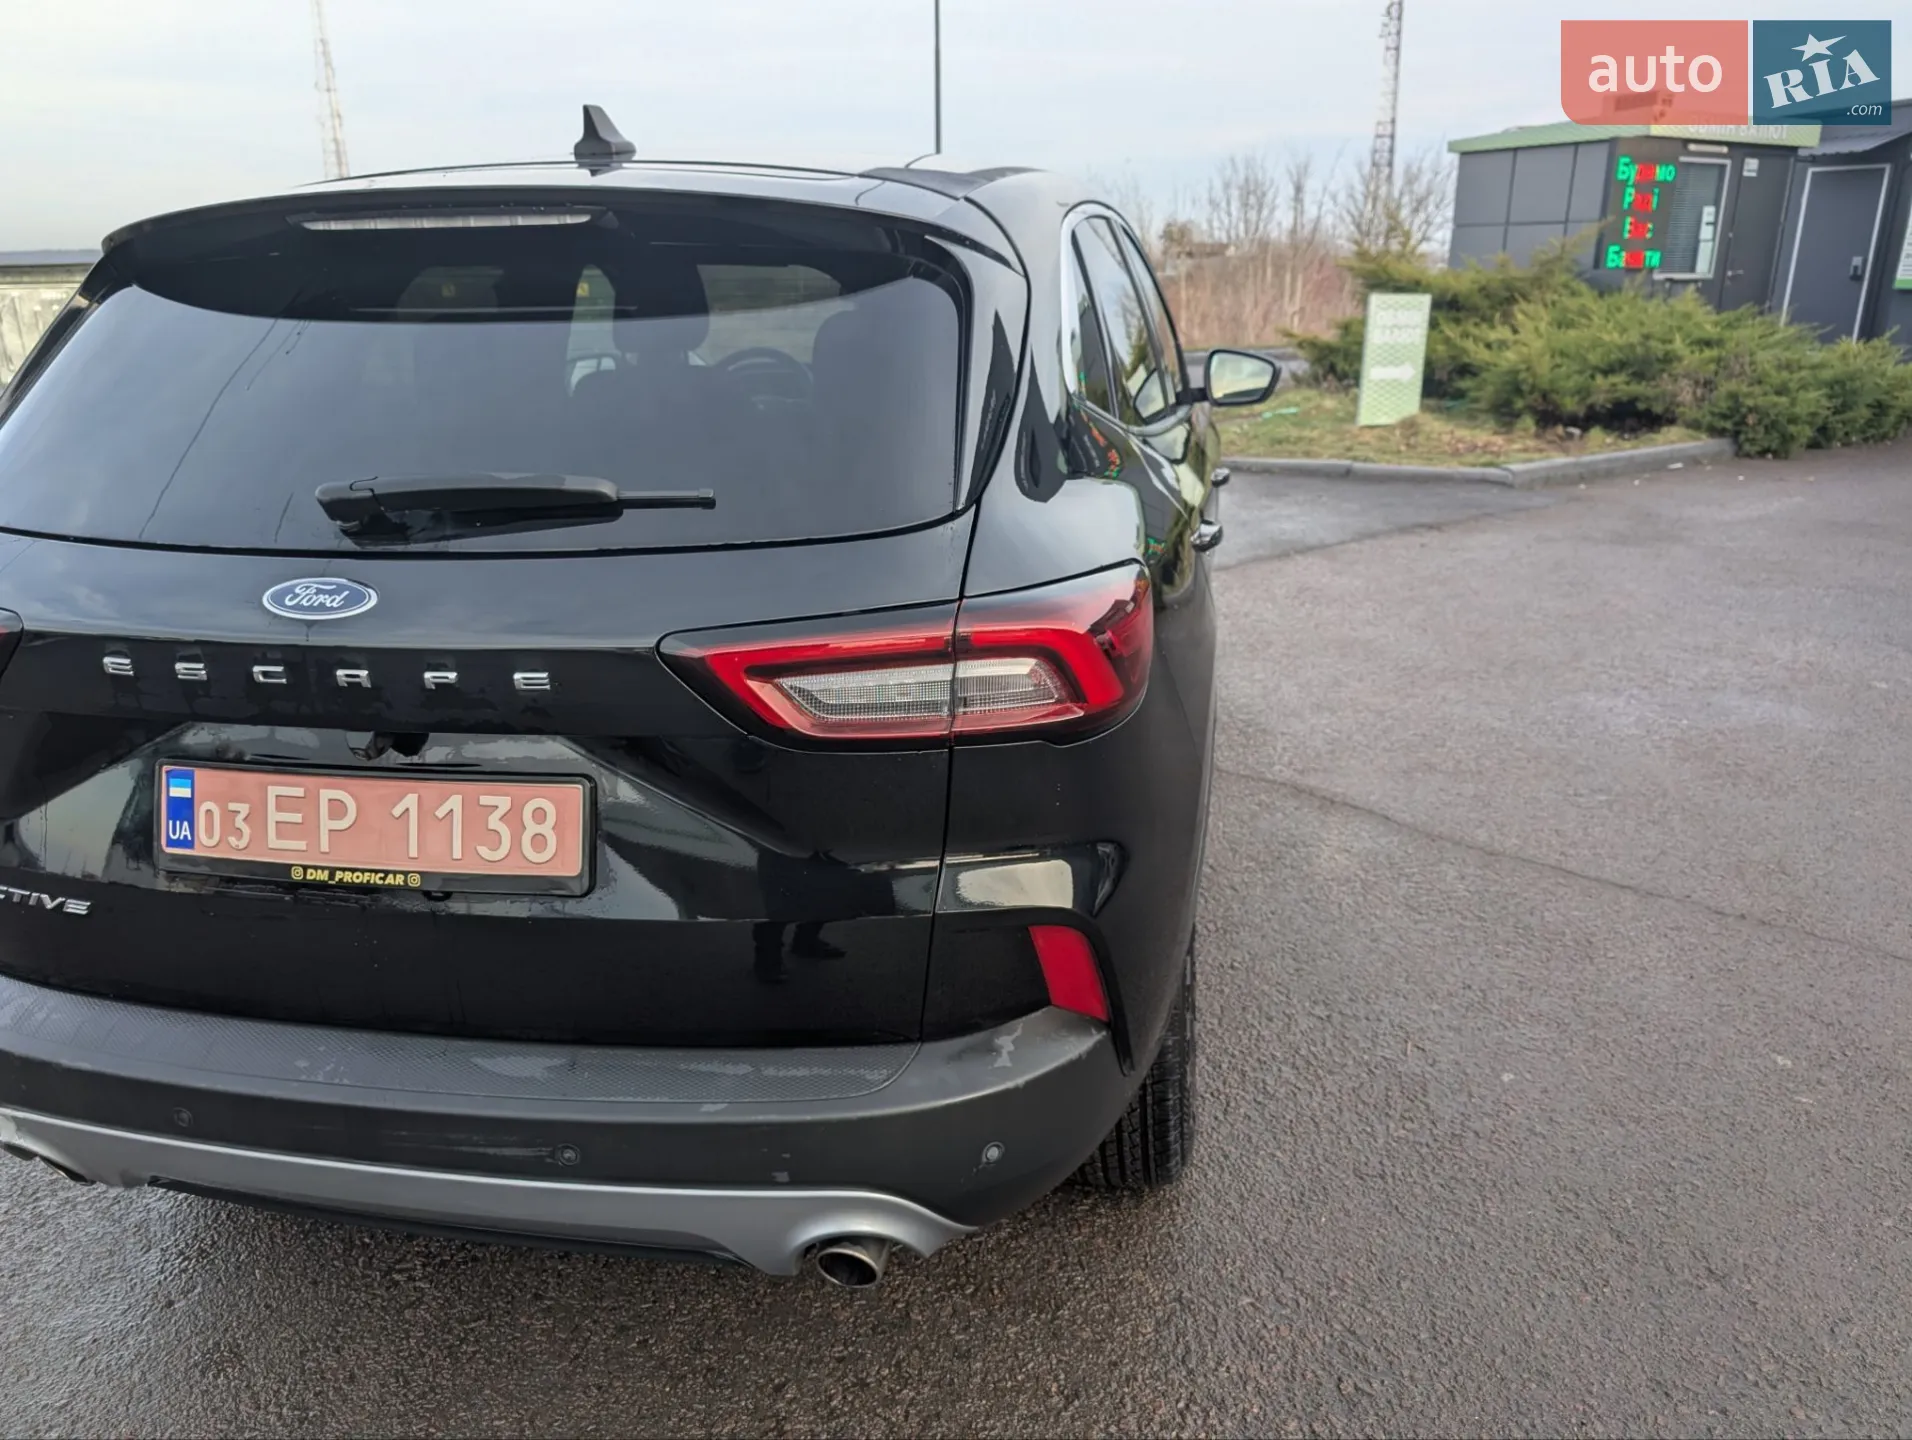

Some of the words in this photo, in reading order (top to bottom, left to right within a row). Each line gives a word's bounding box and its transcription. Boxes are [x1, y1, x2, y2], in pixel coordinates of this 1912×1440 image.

[284, 582, 350, 609] Ford
[102, 655, 551, 690] ESCAPE
[168, 819, 192, 841] UA
[199, 801, 252, 850] 03
[267, 785, 358, 854] EP
[391, 792, 558, 865] 1138
[306, 868, 405, 887] DM_PROFICAR
